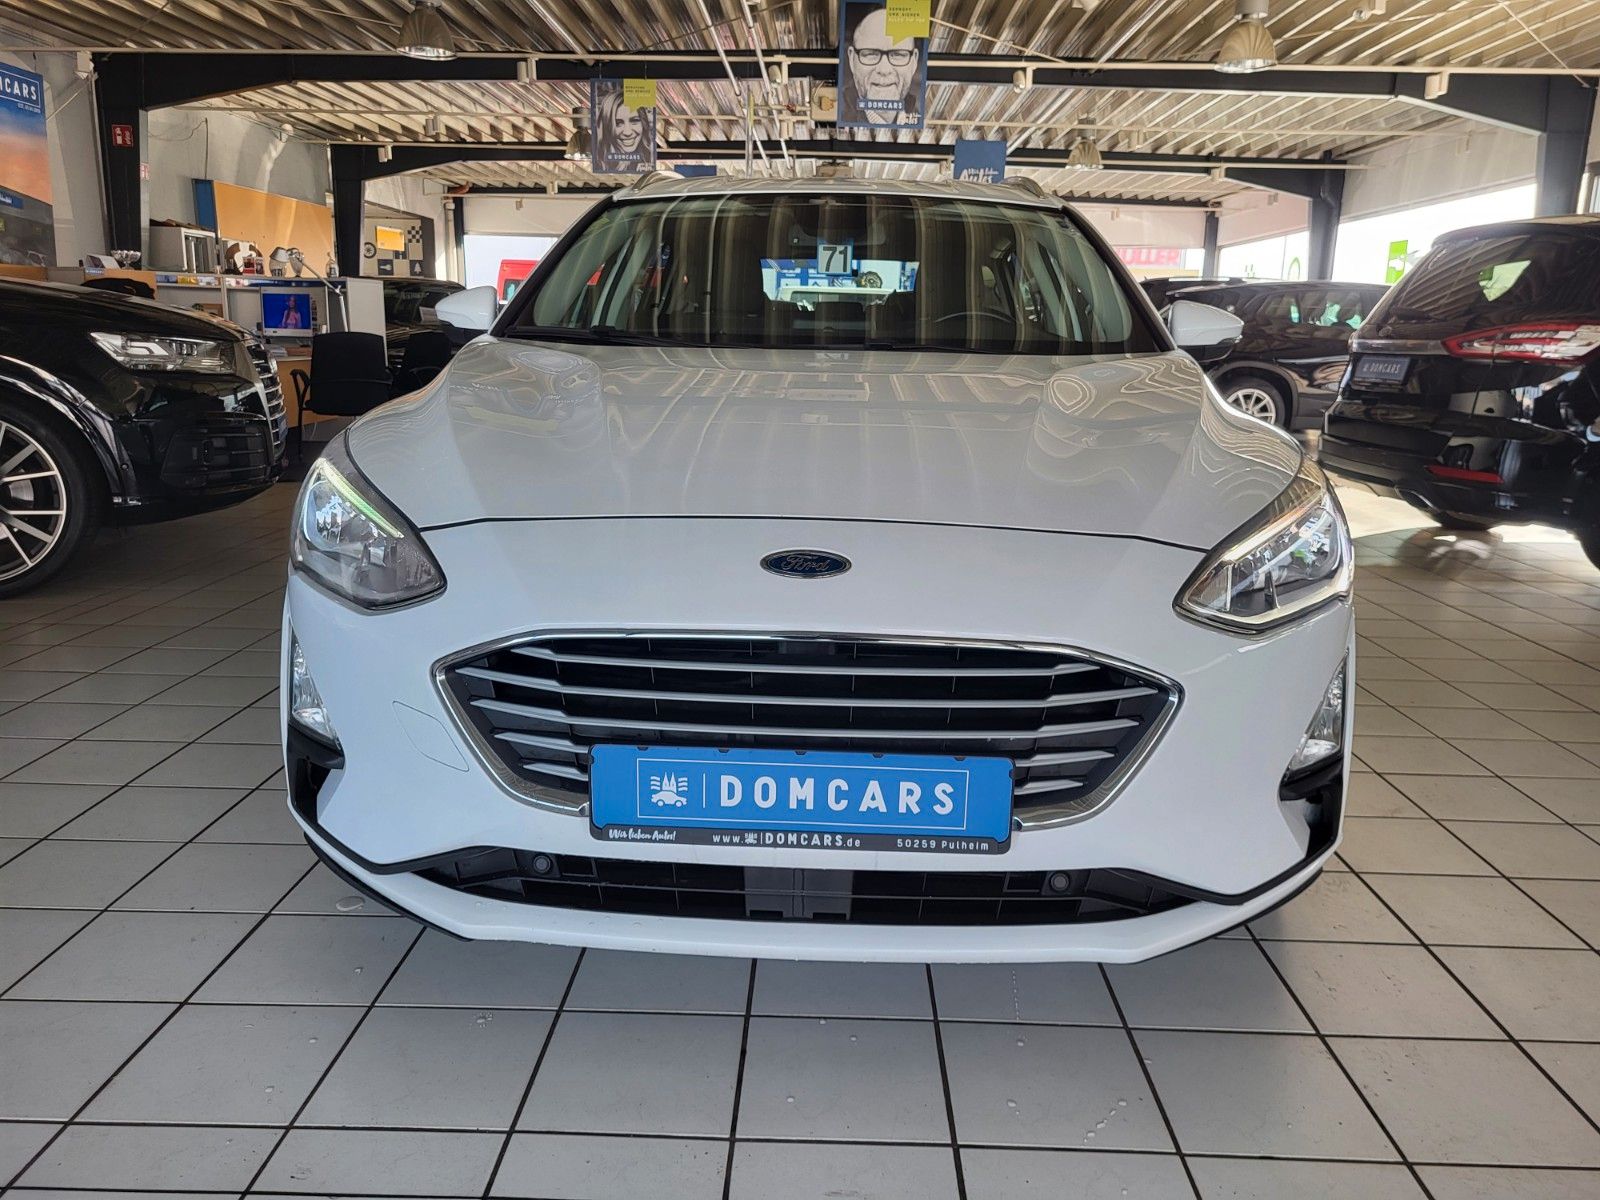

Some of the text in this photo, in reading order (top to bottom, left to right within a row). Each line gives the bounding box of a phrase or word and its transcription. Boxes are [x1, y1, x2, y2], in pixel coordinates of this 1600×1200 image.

[867, 101, 903, 110] DOMCARS
[822, 246, 848, 273] 71
[781, 555, 831, 571] Ford
[720, 774, 955, 816] DOMCARS
[897, 838, 989, 851] 50259 Pulheim
